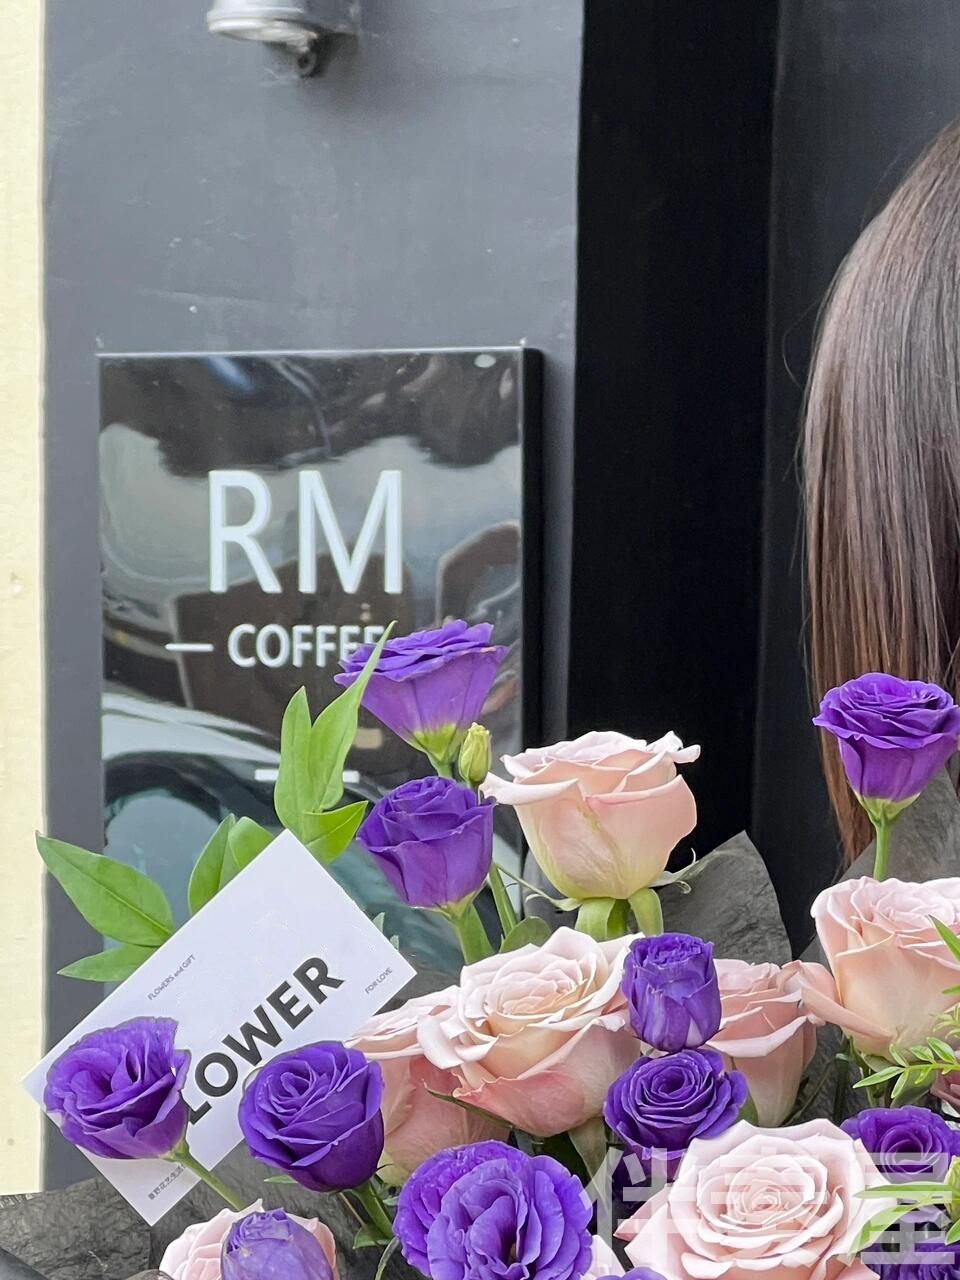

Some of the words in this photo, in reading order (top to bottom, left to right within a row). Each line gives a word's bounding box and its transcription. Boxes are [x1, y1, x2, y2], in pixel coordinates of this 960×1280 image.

[208, 470, 403, 594] RM
[181, 957, 346, 1125] LOWER
[364, 981, 378, 994] FOR
[376, 967, 393, 983] LOVE
